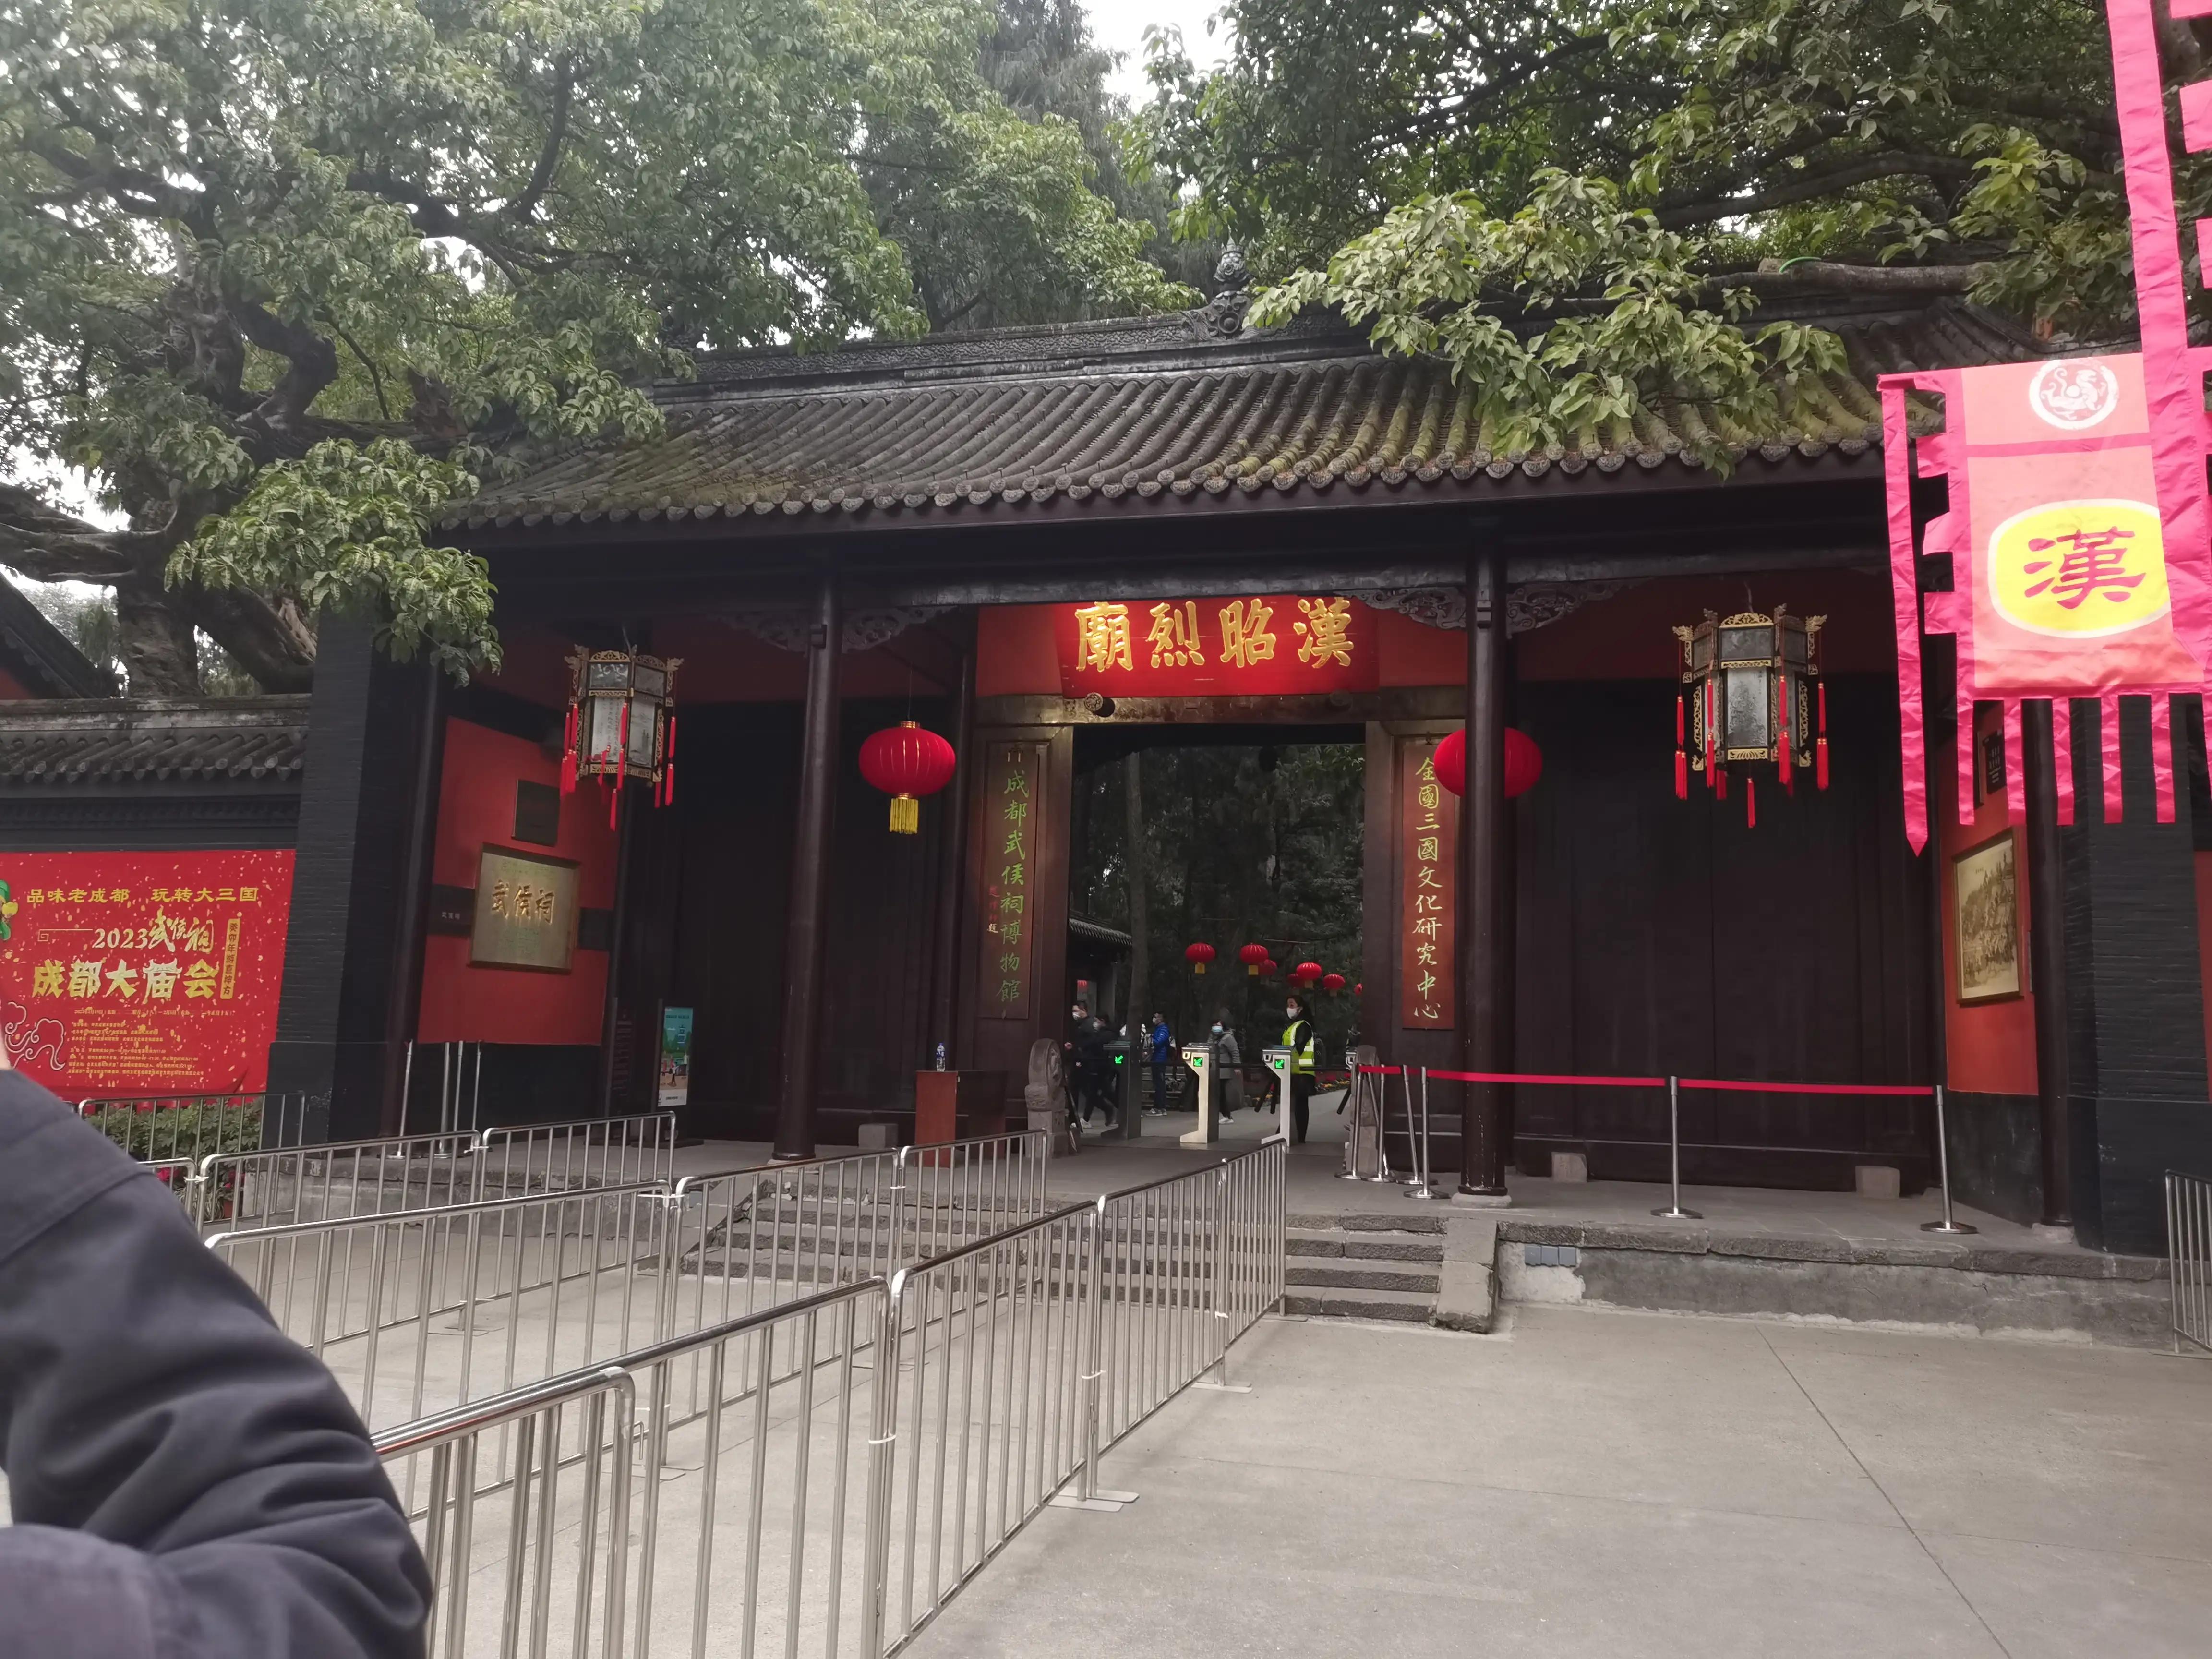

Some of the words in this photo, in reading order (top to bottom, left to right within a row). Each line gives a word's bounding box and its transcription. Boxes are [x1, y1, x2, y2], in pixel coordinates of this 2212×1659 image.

[2023, 526, 2146, 609] 漢
[27, 887, 130, 903] 品味老成都
[151, 887, 258, 903] 玩转大三国
[32, 958, 220, 1004] 成都大庙会
